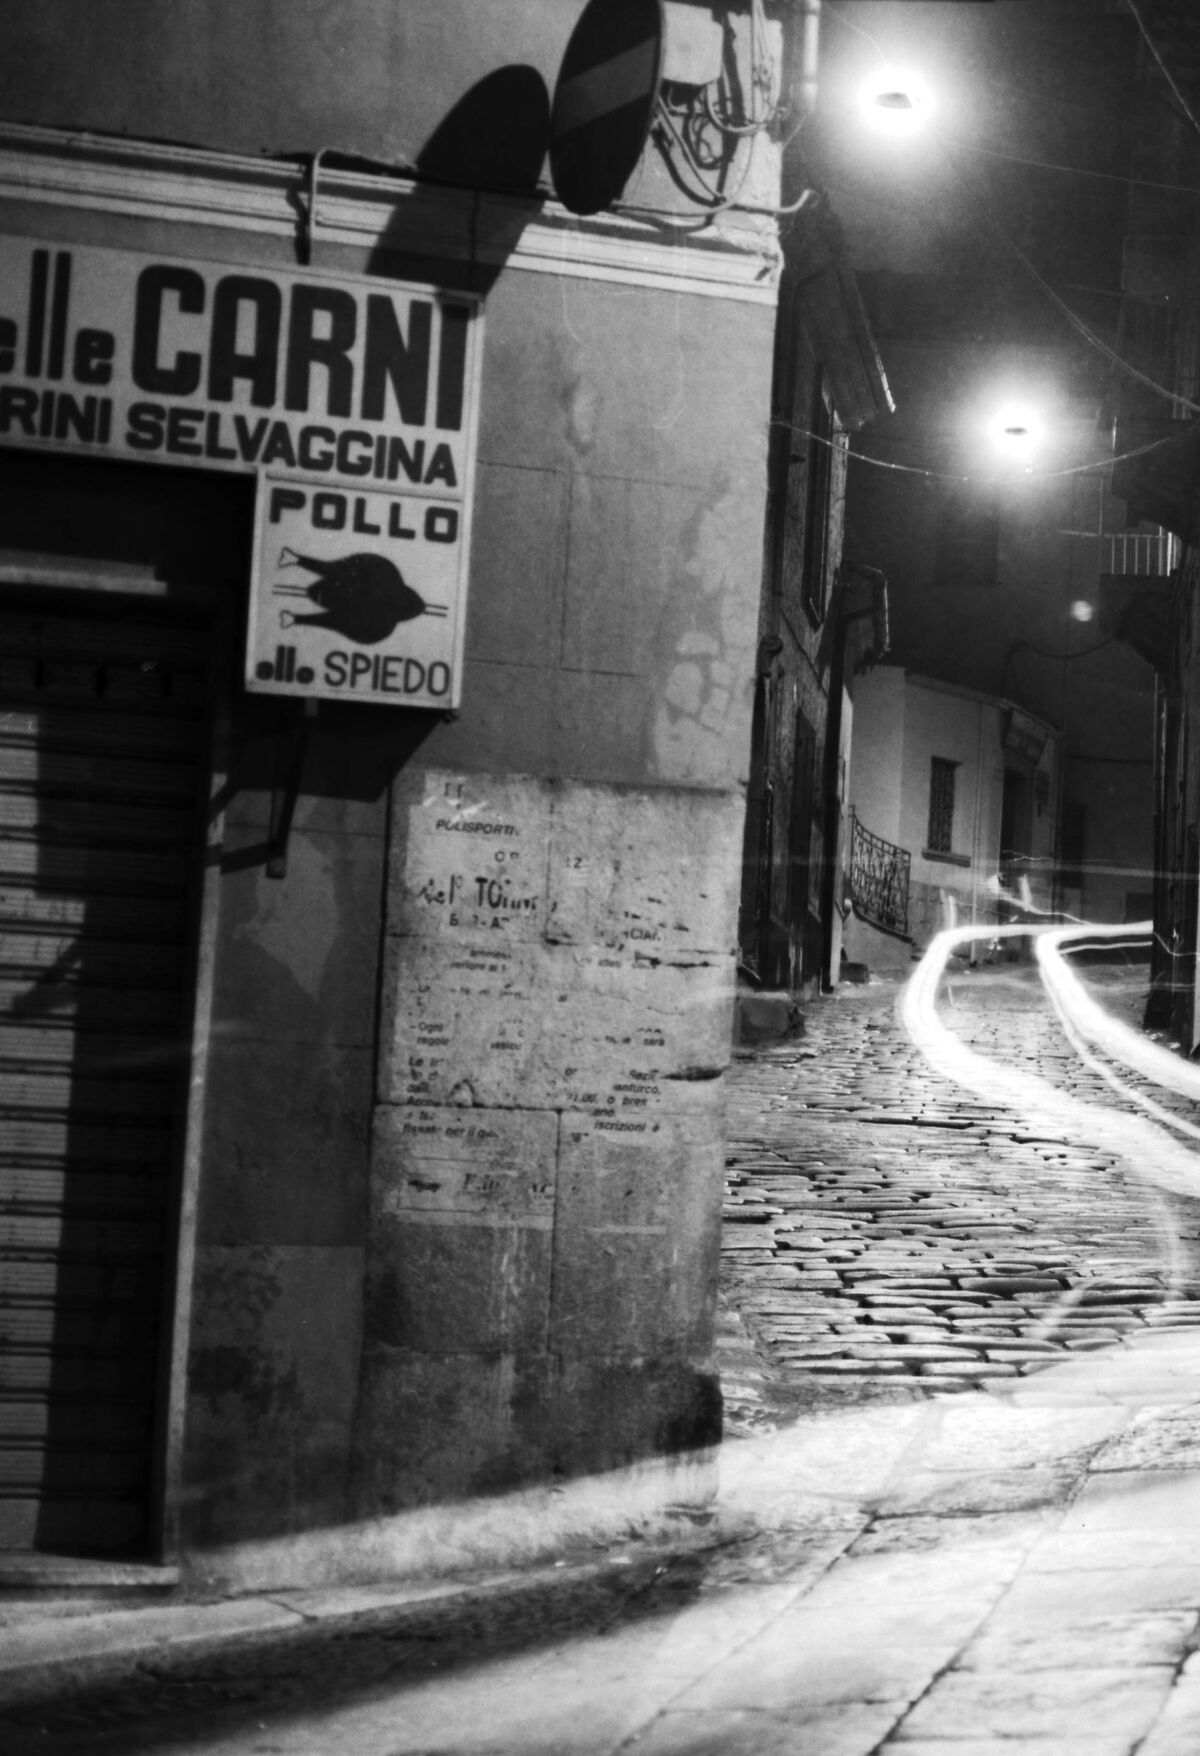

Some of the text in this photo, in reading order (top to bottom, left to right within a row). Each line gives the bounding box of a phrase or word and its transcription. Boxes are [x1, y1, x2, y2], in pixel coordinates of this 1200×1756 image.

[131, 264, 469, 432] CARNI
[125, 402, 457, 488] SELVAGGINA
[269, 488, 459, 544] POLLO
[324, 651, 451, 697] SPIEDO
[595, 1121, 646, 1132] iscrizioni
